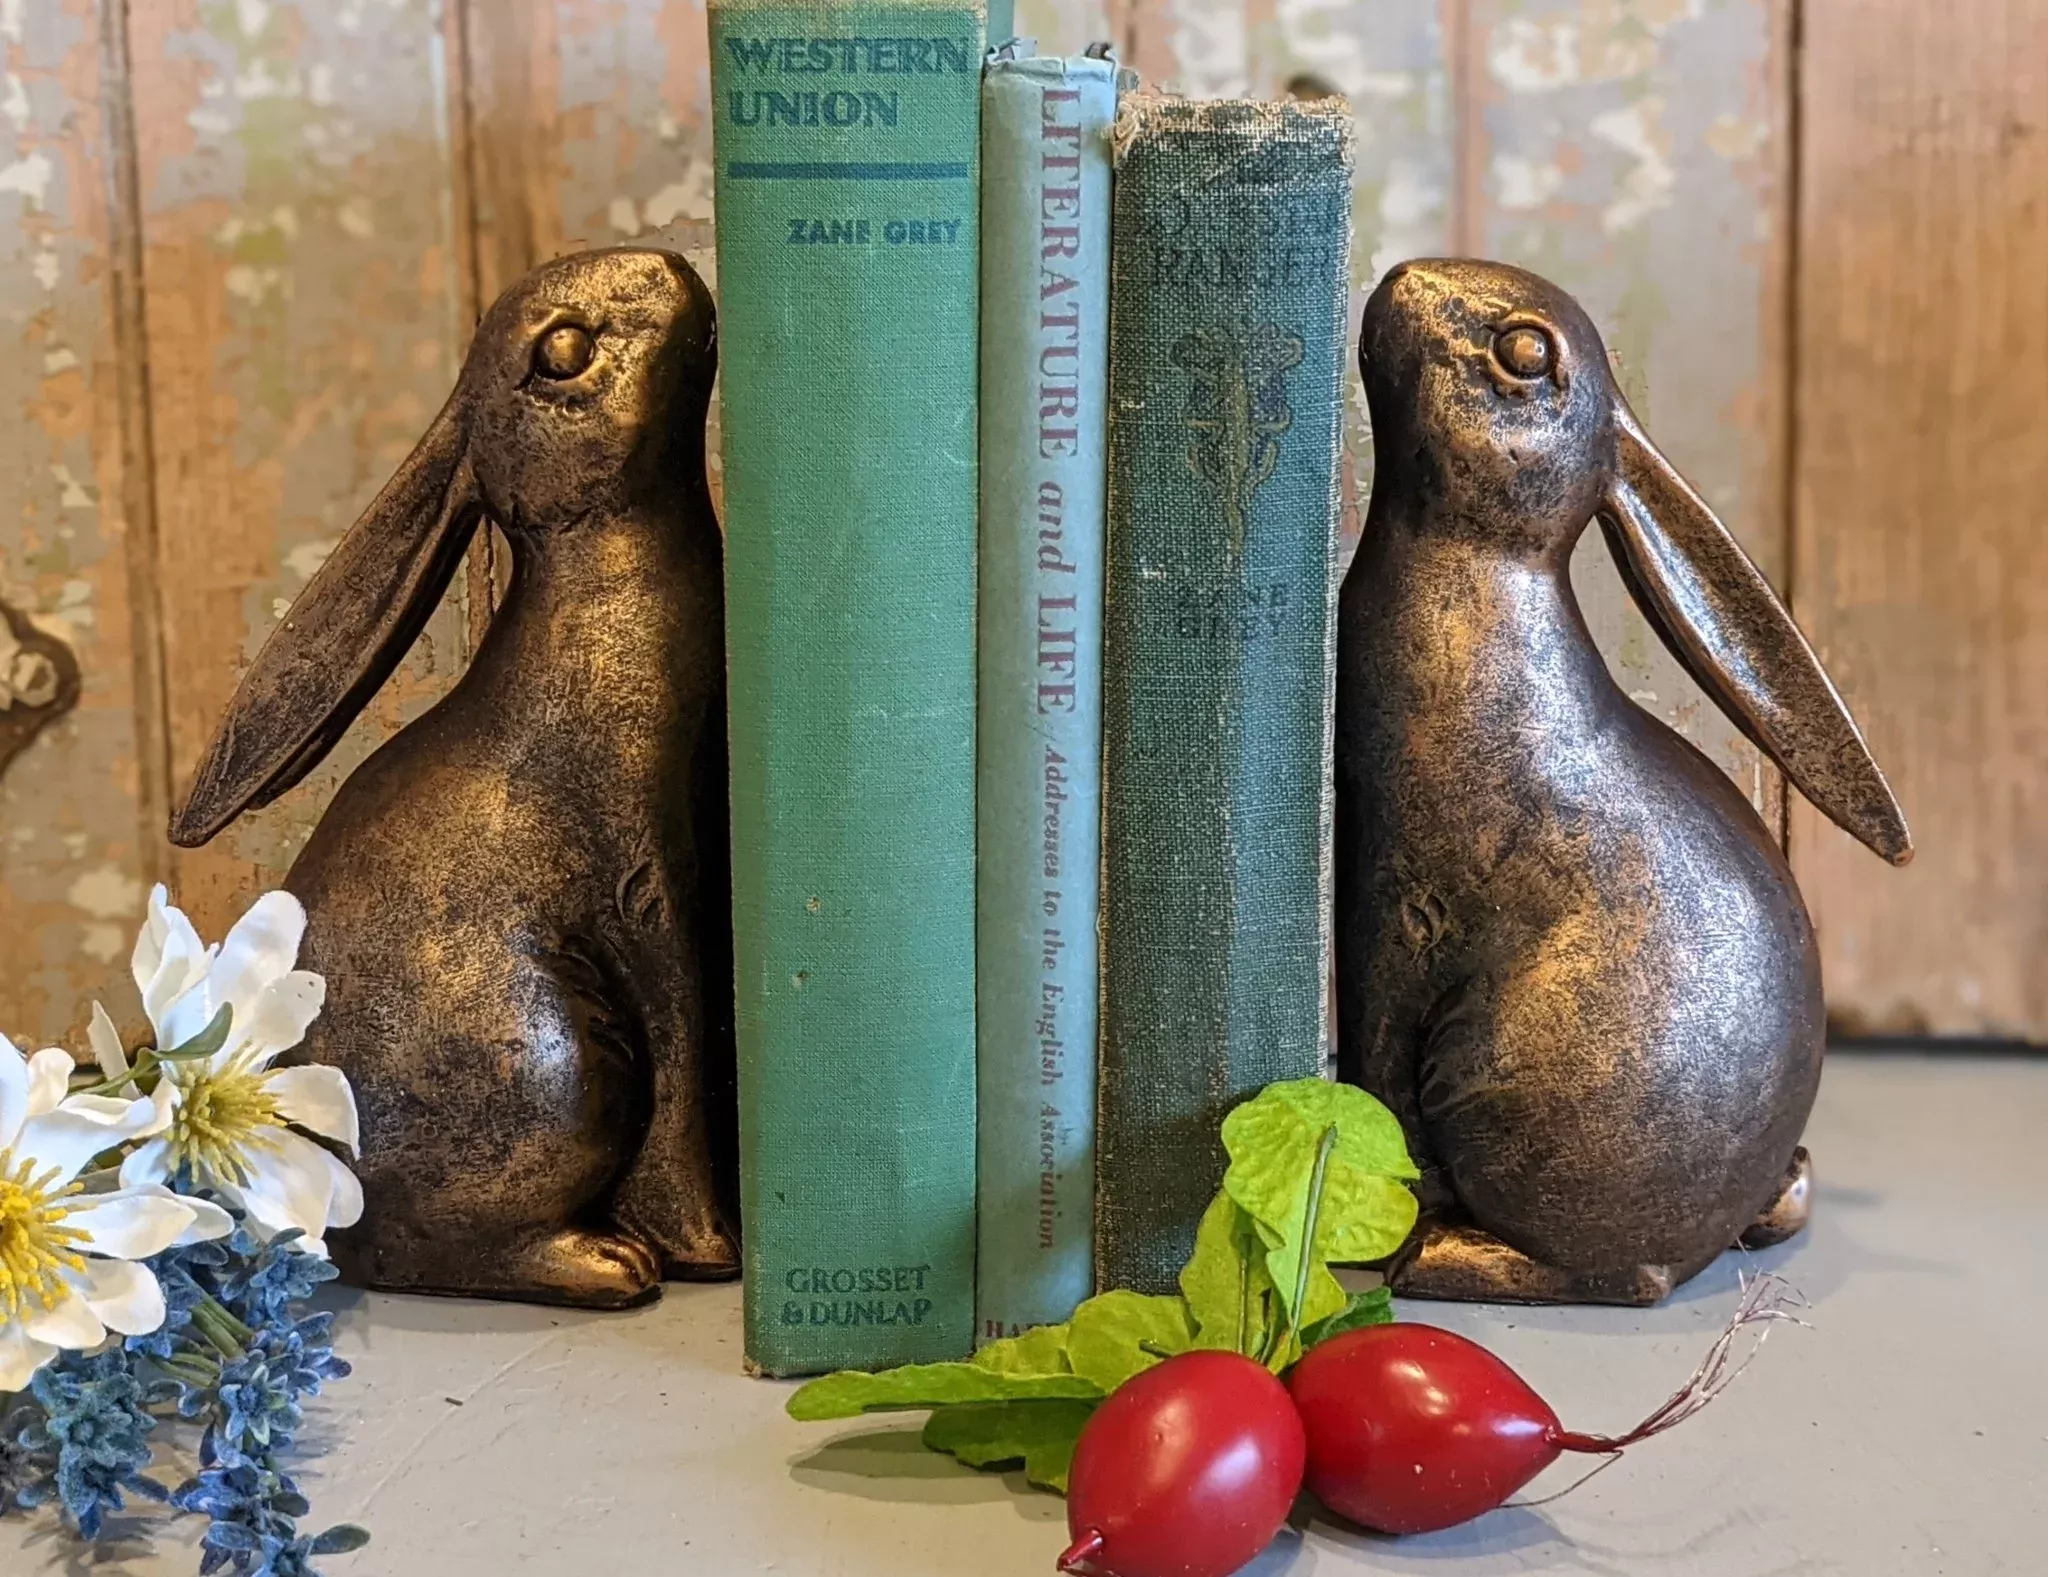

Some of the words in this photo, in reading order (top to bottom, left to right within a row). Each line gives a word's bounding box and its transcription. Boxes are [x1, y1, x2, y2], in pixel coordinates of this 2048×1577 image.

[726, 37, 970, 75] WESTERN
[729, 91, 898, 128] UNION
[786, 218, 871, 245] ZANE
[883, 217, 961, 245] GREY
[1038, 86, 1082, 460] LITERATURE
[1037, 481, 1077, 574] and
[1037, 592, 1077, 715] LIFE
[1043, 744, 1069, 879] Addresses
[1042, 890, 1063, 917] to
[1042, 928, 1066, 970] the
[1035, 982, 1065, 1086] English
[1038, 1101, 1064, 1249] Association
[785, 1263, 932, 1293] GROSSET
